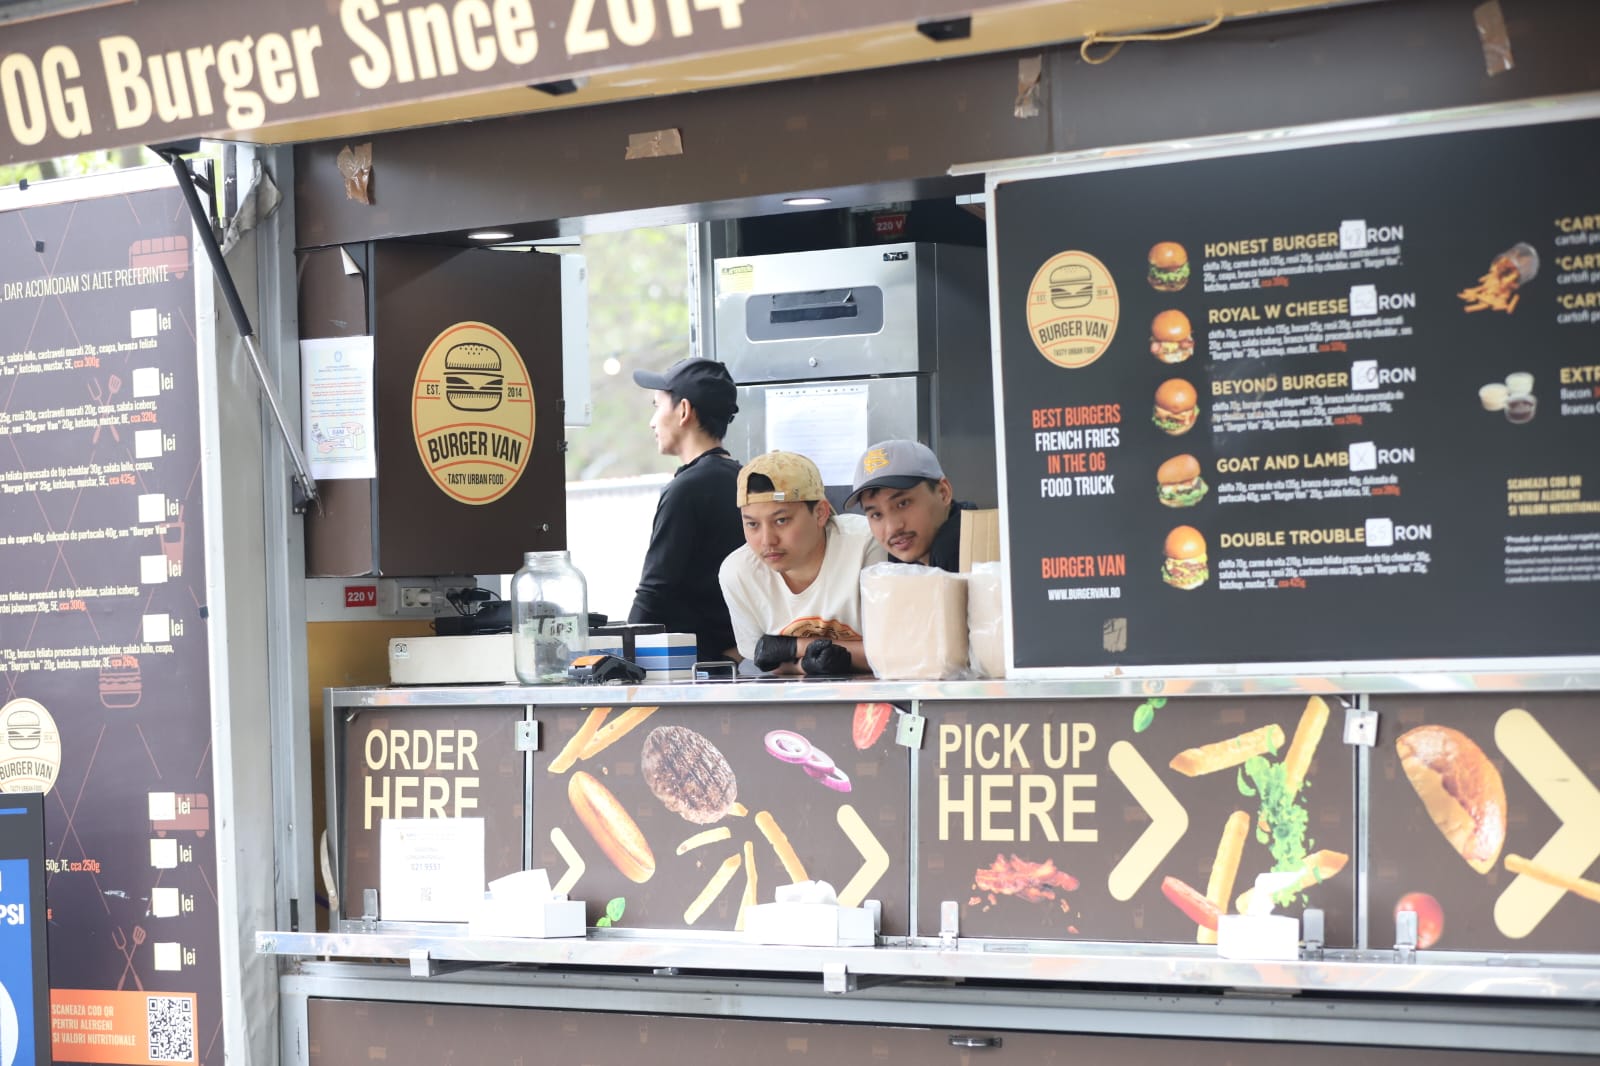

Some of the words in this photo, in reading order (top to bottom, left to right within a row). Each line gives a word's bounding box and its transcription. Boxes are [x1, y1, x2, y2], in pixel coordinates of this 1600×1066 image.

[2, 44, 93, 146] OG
[100, 24, 324, 130] Burger
[340, 0, 539, 92] Since
[877, 221, 893, 231] 220
[895, 220, 903, 229] V
[1204, 238, 1268, 257] HONEST
[1273, 232, 1338, 252] BURGER
[1367, 225, 1404, 242] RON
[4, 282, 23, 300] DAR
[25, 276, 79, 298] ACOMODAM
[81, 274, 90, 291] SI
[92, 271, 112, 290] ALTE
[115, 265, 168, 288] PREFERINTE
[1208, 307, 1260, 324] ROYAL
[1264, 304, 1281, 319] W
[1286, 299, 1348, 317] CHEESE
[1378, 293, 1416, 310] RON
[159, 313, 171, 330] lei
[1038, 320, 1082, 344] BURGER
[1086, 320, 1108, 340] VAN
[161, 373, 173, 390] lei
[427, 384, 440, 395] EST.
[1212, 377, 1278, 396] BEYOND
[1282, 373, 1348, 391] BURGER
[1379, 367, 1416, 384] RON
[507, 387, 522, 398] 2014
[1560, 387, 1592, 400] Bacon
[1032, 408, 1062, 429] BEST
[1065, 404, 1121, 426] BURGERS
[1561, 403, 1594, 416] Branza
[163, 434, 176, 452] lei
[428, 431, 488, 463] BURGER
[492, 433, 521, 464] VAN
[1035, 430, 1083, 452] FRENCH
[1085, 428, 1120, 448] FRIES
[1048, 455, 1060, 474] IN
[1063, 453, 1086, 473] THE
[1089, 452, 1106, 472] OG
[1217, 457, 1260, 472] GOAT
[1264, 455, 1299, 470] AND
[1304, 451, 1349, 468] LAMB
[1378, 448, 1415, 464] RON
[448, 474, 466, 485] TASTY
[468, 474, 488, 485] URBAN
[489, 474, 504, 485] FOOD
[1041, 478, 1072, 498] FOOD
[1074, 475, 1115, 496] TRUCK
[167, 499, 179, 516] lei
[1221, 531, 1286, 548] DOUBLE
[1289, 528, 1365, 545] TROUBLE
[1395, 525, 1432, 541] RON
[169, 560, 181, 578] lei
[1042, 557, 1095, 579] BURGER
[1097, 554, 1126, 577] VAN
[347, 591, 366, 602] 220
[367, 590, 374, 602] V
[1048, 587, 1120, 601] WWW.BURGERVAN.RO
[171, 619, 183, 637] lei
[534, 614, 573, 636] Tips
[365, 729, 479, 771] ORDER
[939, 723, 1030, 769] PICK
[1043, 722, 1096, 768] UP
[0, 760, 32, 780] BURGER
[35, 762, 53, 780] VAN
[178, 797, 190, 815] lei
[364, 776, 480, 830] HERE
[938, 774, 1098, 842] HERE
[180, 845, 192, 862] lei
[70, 862, 81, 871] cca
[181, 894, 194, 912] lei
[184, 949, 196, 965] lei
[52, 1004, 86, 1016] SCANEAZA
[88, 1005, 102, 1016] COD
[104, 1006, 114, 1017] QR
[52, 1018, 78, 1029] PENTRU
[80, 1019, 113, 1030] ALERGENI
[53, 1032, 59, 1043] SI
[61, 1033, 86, 1044] VALORI
[87, 1034, 136, 1046] NUTRITIONALE
